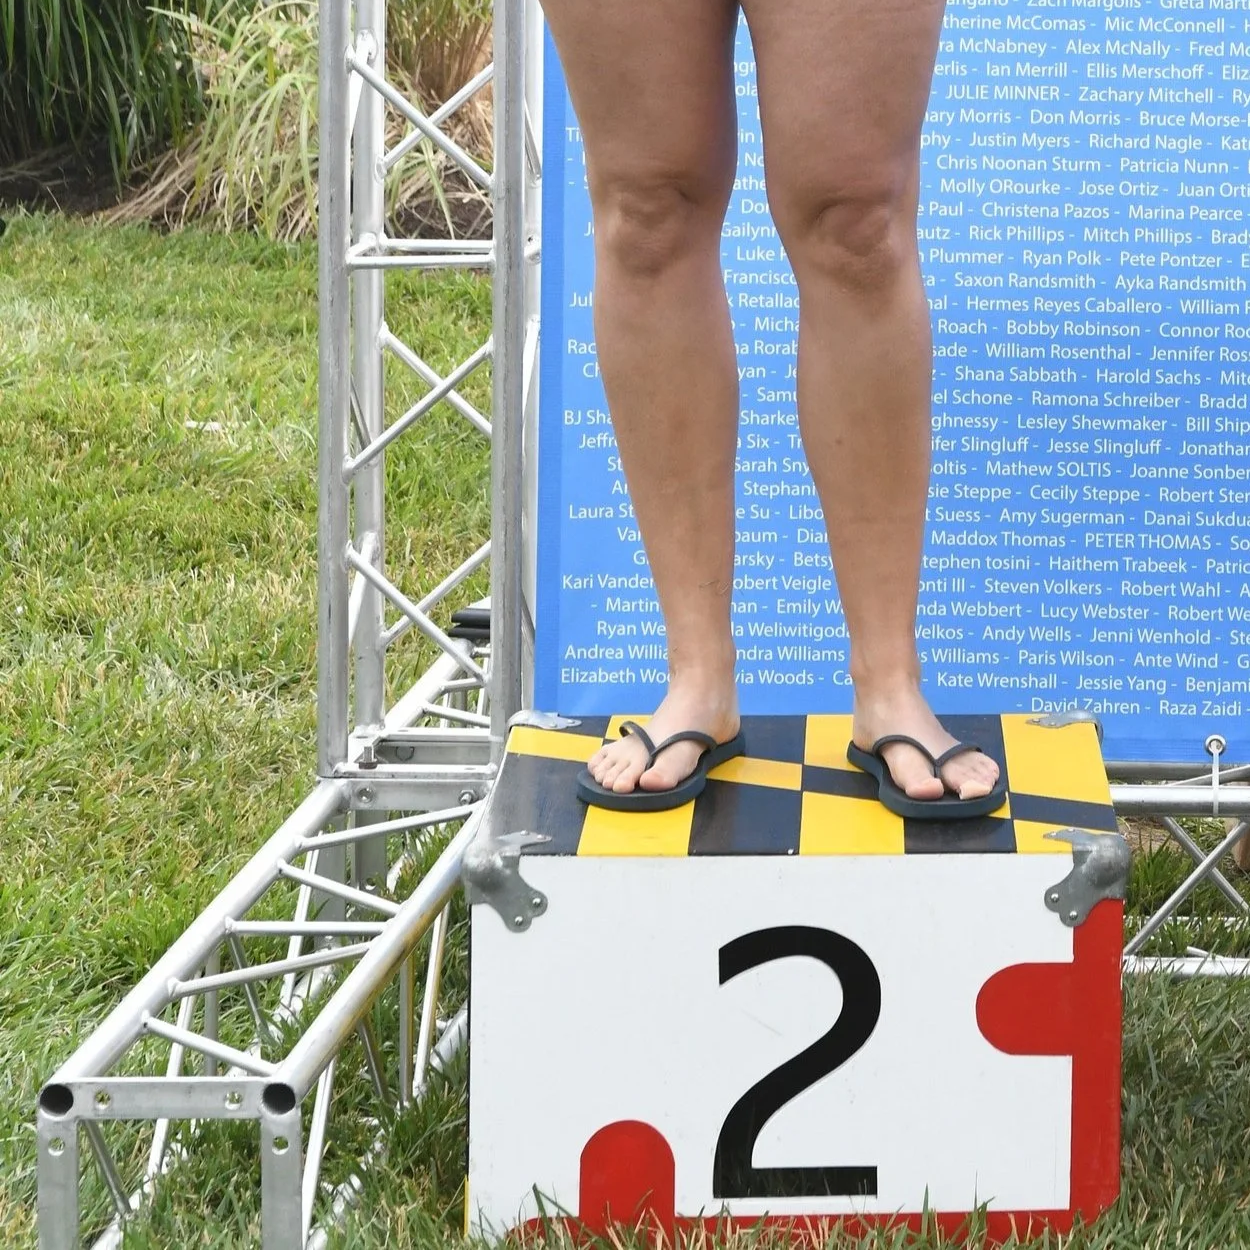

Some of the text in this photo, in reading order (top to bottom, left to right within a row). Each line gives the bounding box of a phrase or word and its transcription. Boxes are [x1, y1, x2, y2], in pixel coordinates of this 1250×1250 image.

[969, 224, 1193, 247] Rick Phillips Mitch Phillips
[1186, 416, 1210, 432] Bill
[984, 577, 1221, 598] Steven Volkers Robert Wahl
[606, 597, 660, 614] Martin
[564, 644, 624, 660] Andrea
[561, 667, 636, 684] Elizabeth
[1159, 699, 1197, 716] Raza
[1201, 700, 1242, 717] Zaidi
[713, 925, 882, 1199] 2
